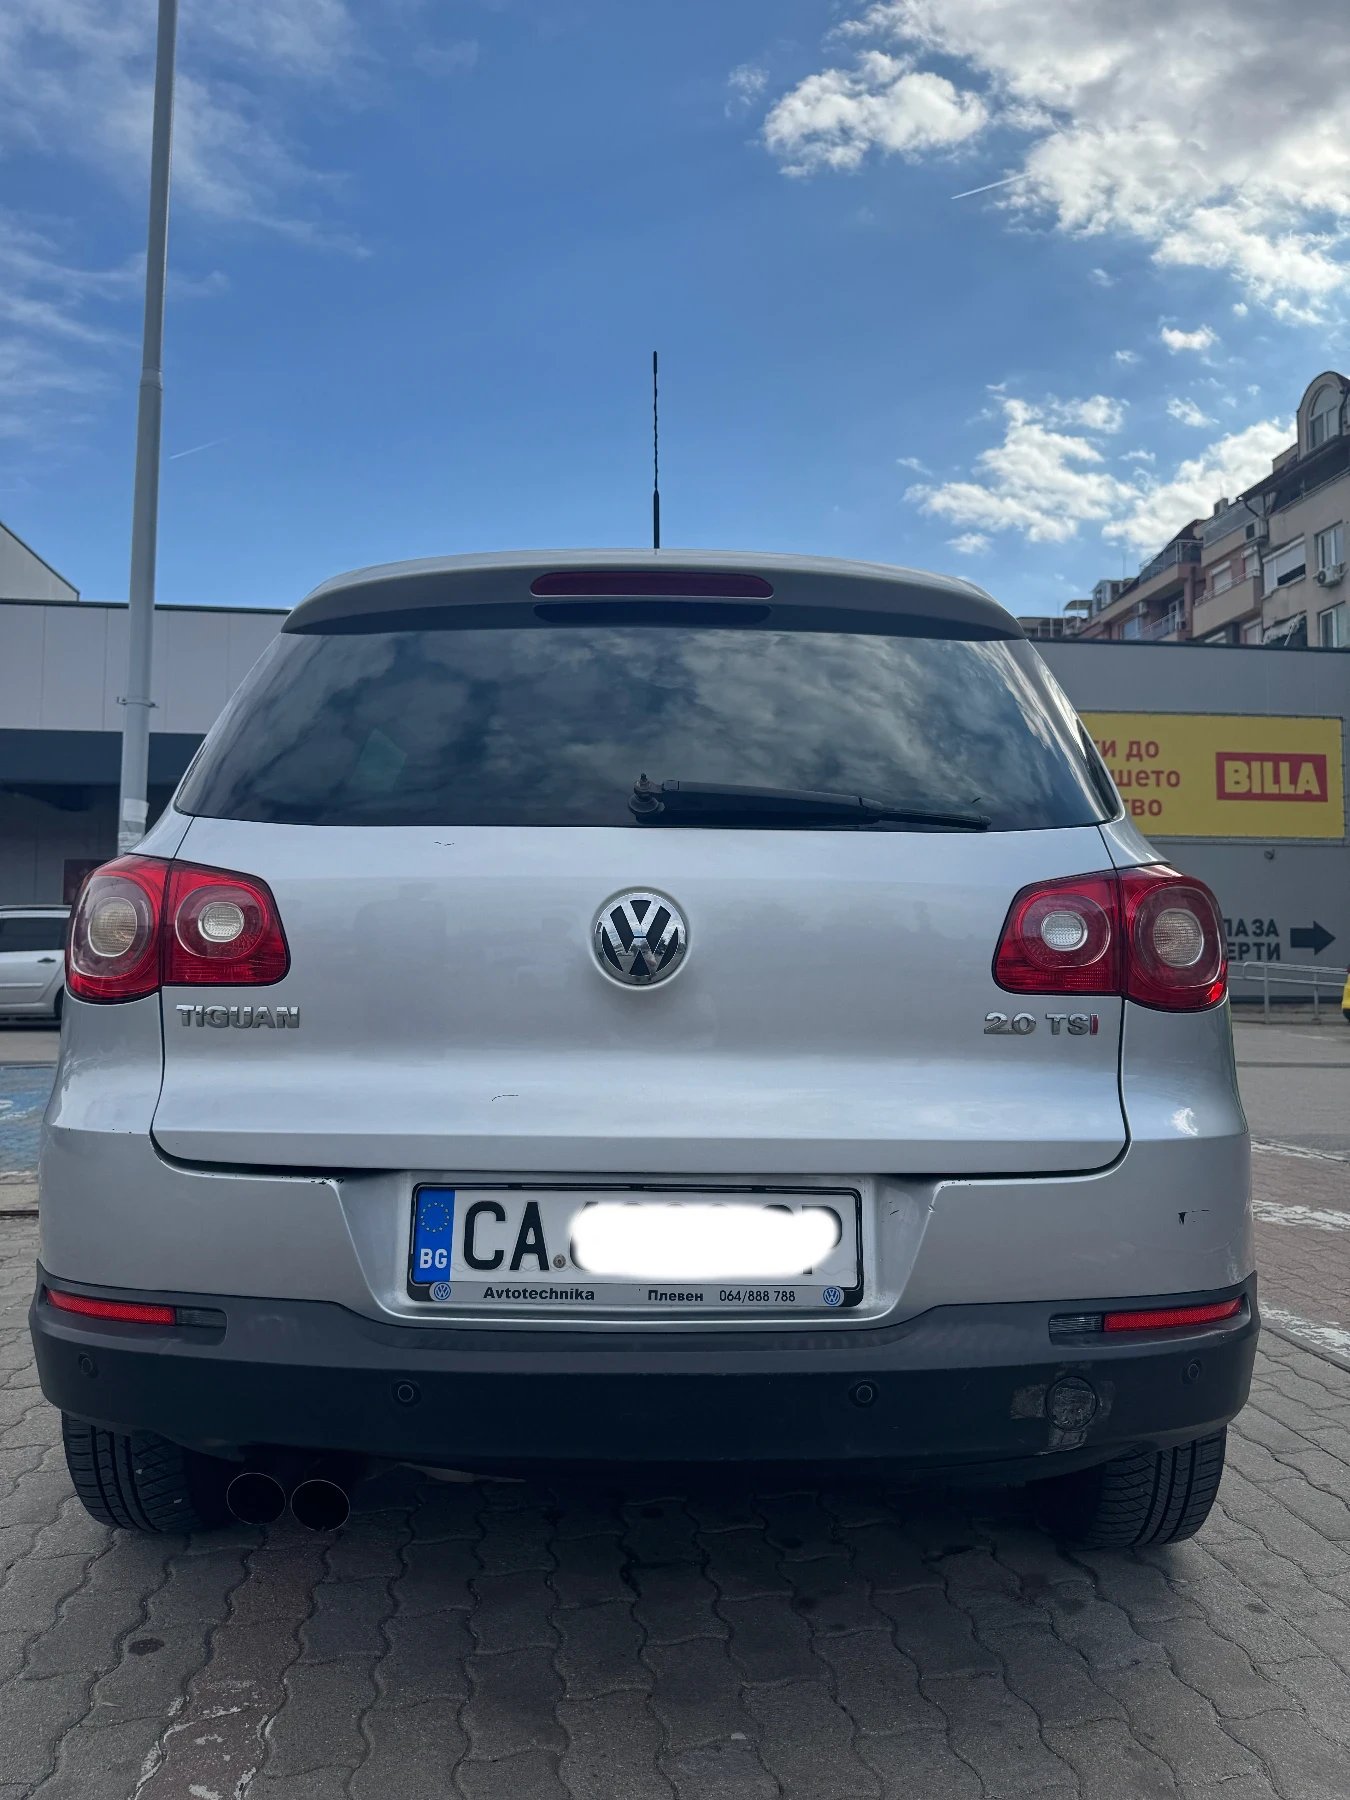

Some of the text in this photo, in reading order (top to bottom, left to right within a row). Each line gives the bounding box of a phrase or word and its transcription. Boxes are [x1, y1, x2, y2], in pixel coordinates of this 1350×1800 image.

[1125, 740, 1160, 762] до
[1223, 760, 1321, 795] BILLA
[175, 1004, 300, 1029] TIGUAN
[1045, 1012, 1099, 1036] TSI
[419, 1248, 448, 1269] BG
[483, 1286, 595, 1301] Avtotechnika
[647, 1289, 796, 1304] Плевен 064/888 788
